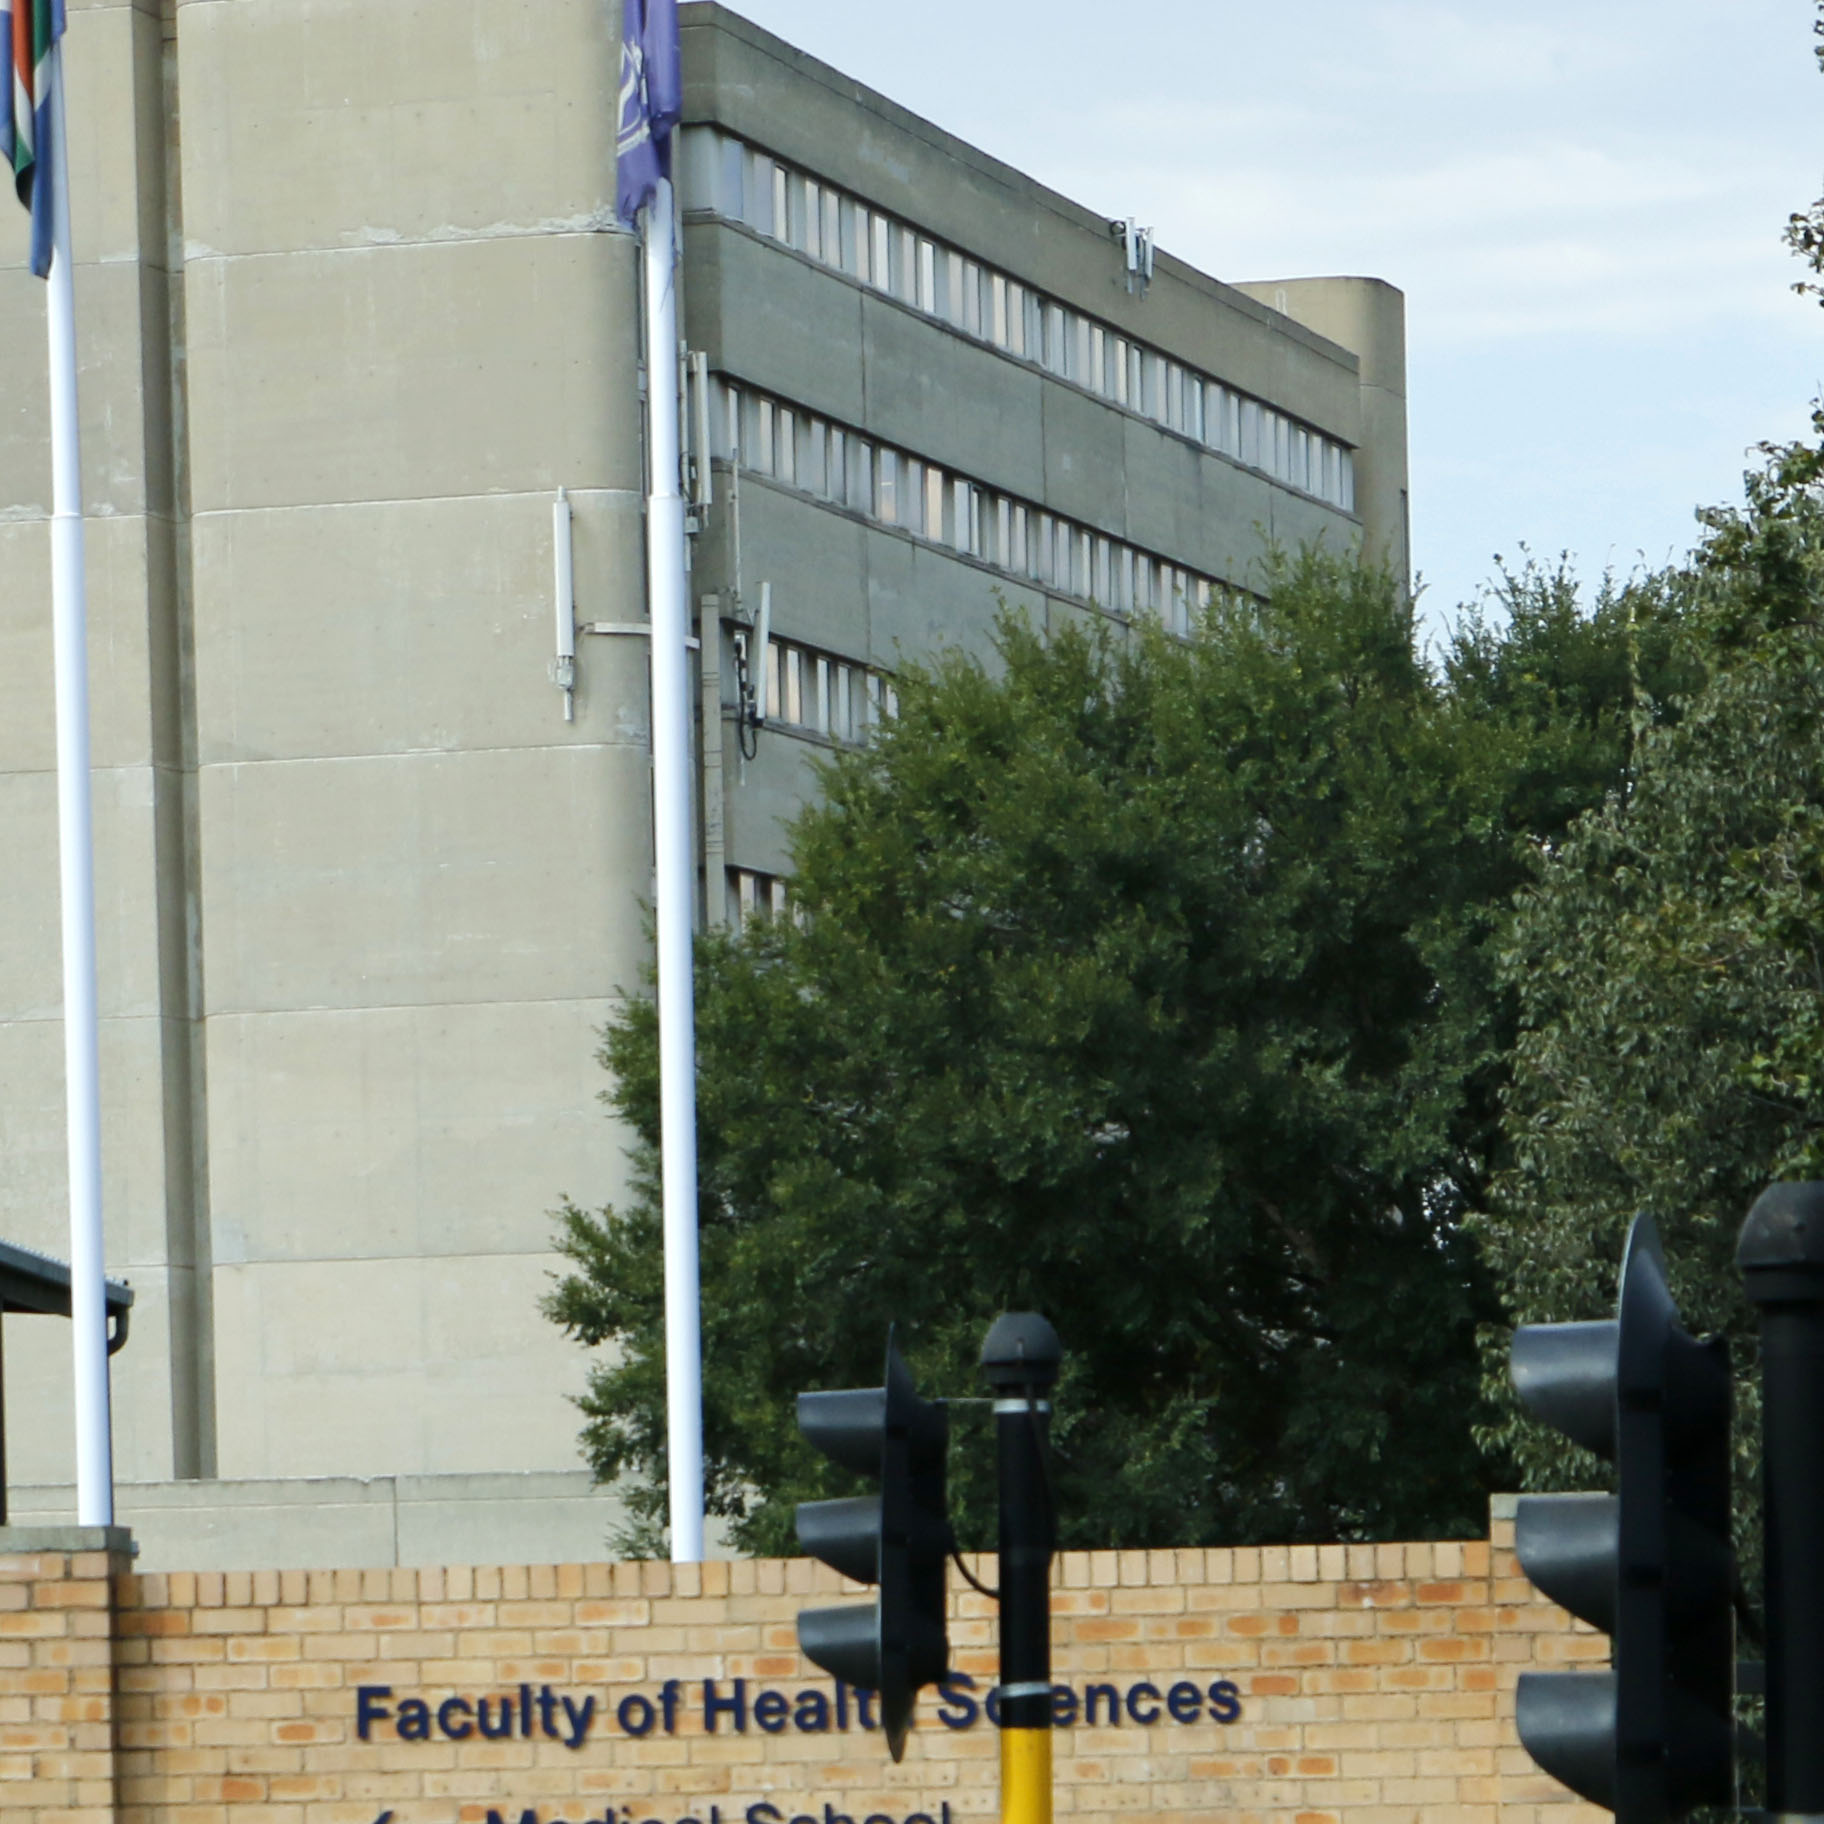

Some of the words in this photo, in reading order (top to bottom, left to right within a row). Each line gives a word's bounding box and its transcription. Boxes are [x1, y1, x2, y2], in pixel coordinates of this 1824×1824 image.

[355, 1682, 596, 1750] Faculty
[616, 1678, 684, 1737] of
[703, 1677, 914, 1733] Healt
